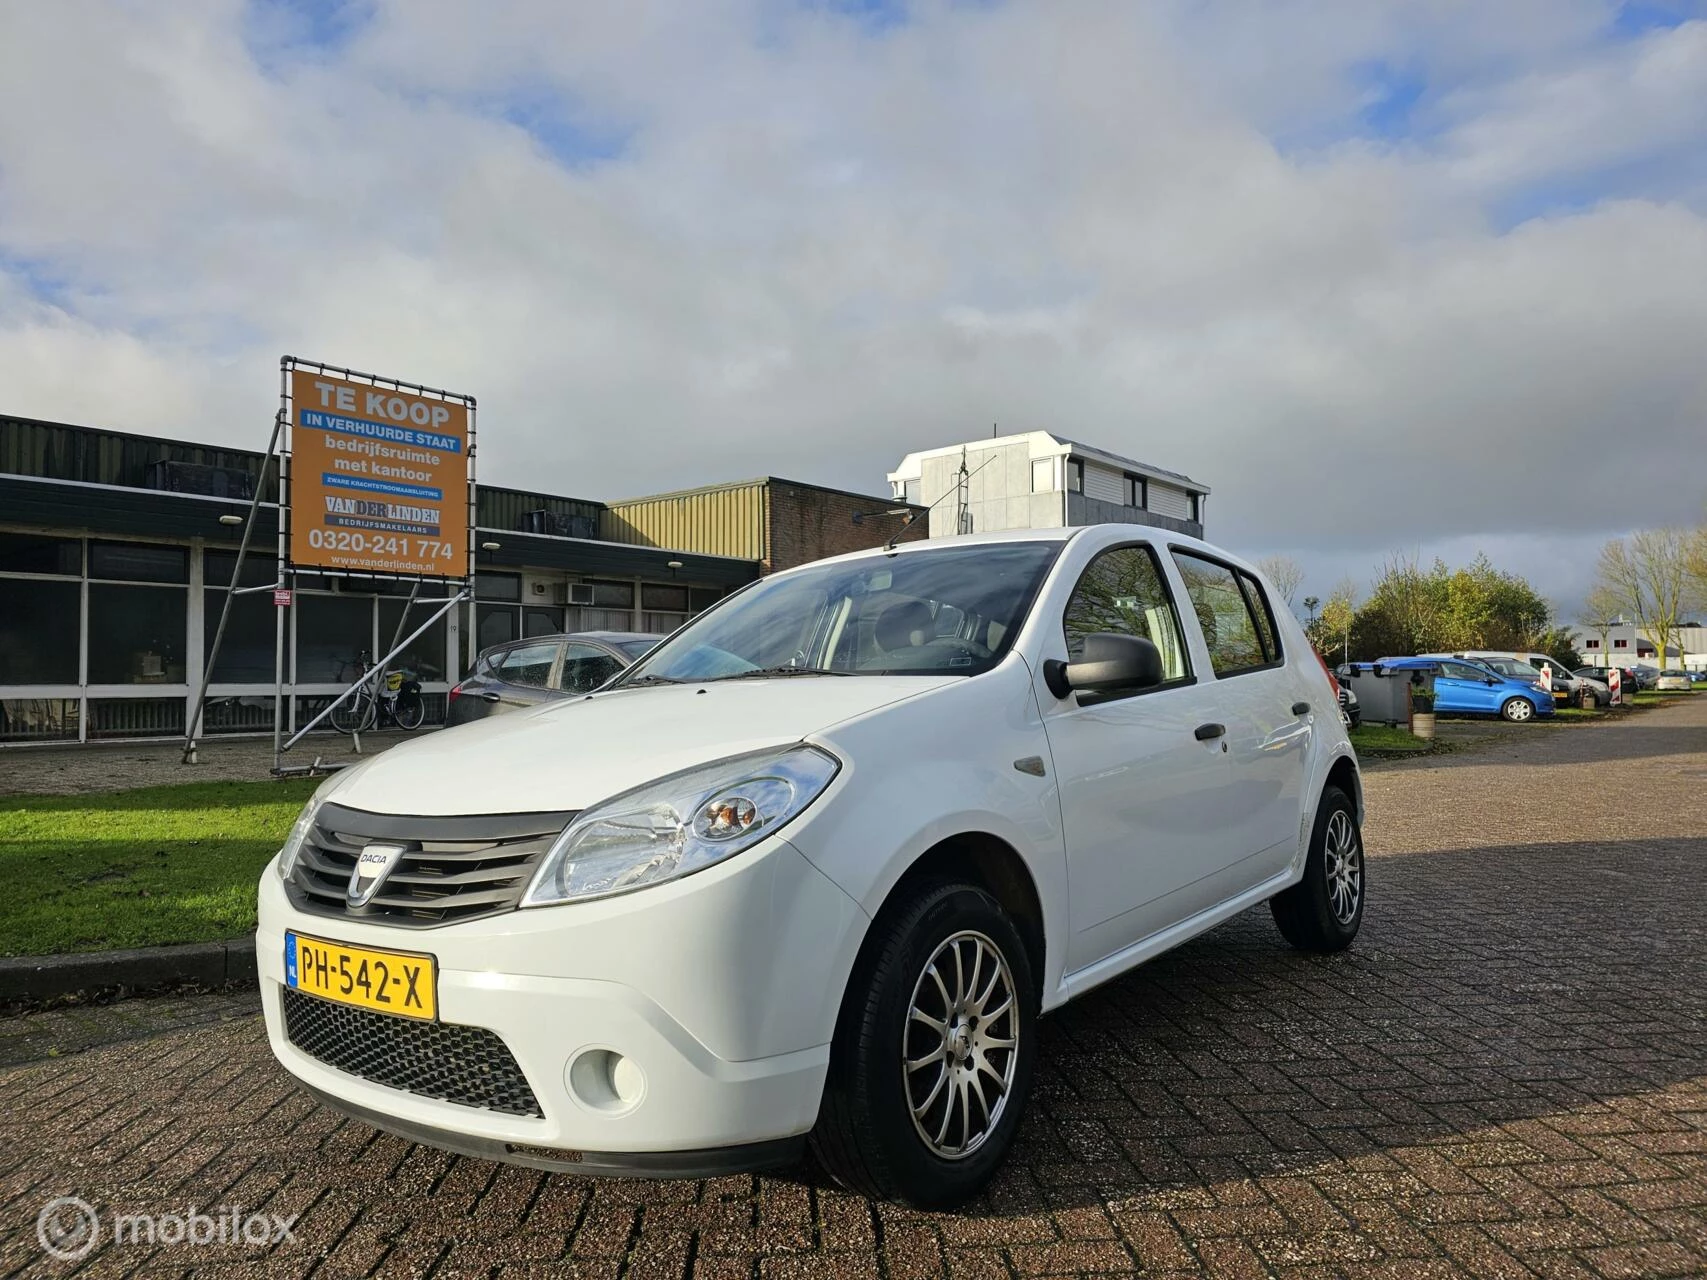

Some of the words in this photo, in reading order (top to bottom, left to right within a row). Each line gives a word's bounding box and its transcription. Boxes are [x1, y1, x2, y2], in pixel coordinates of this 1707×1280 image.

[315, 381, 356, 412] TE
[366, 391, 449, 428] KOOP
[306, 413, 322, 426] IN
[326, 416, 413, 442] VERHUURDE
[416, 434, 456, 450] STAAT
[325, 435, 440, 465] bedrijfsruimte
[327, 477, 350, 485] ZWARE
[335, 457, 367, 472] met
[371, 461, 432, 482] kantoor
[339, 518, 427, 534] BEDRIJFSMAKELAARS
[309, 529, 408, 556] 0320-241
[417, 540, 453, 560] 774
[331, 555, 435, 571] www.vanderlinden.nl
[360, 854, 387, 864] DACIA
[289, 965, 297, 978] NL
[302, 946, 423, 1009] PH-542-X
